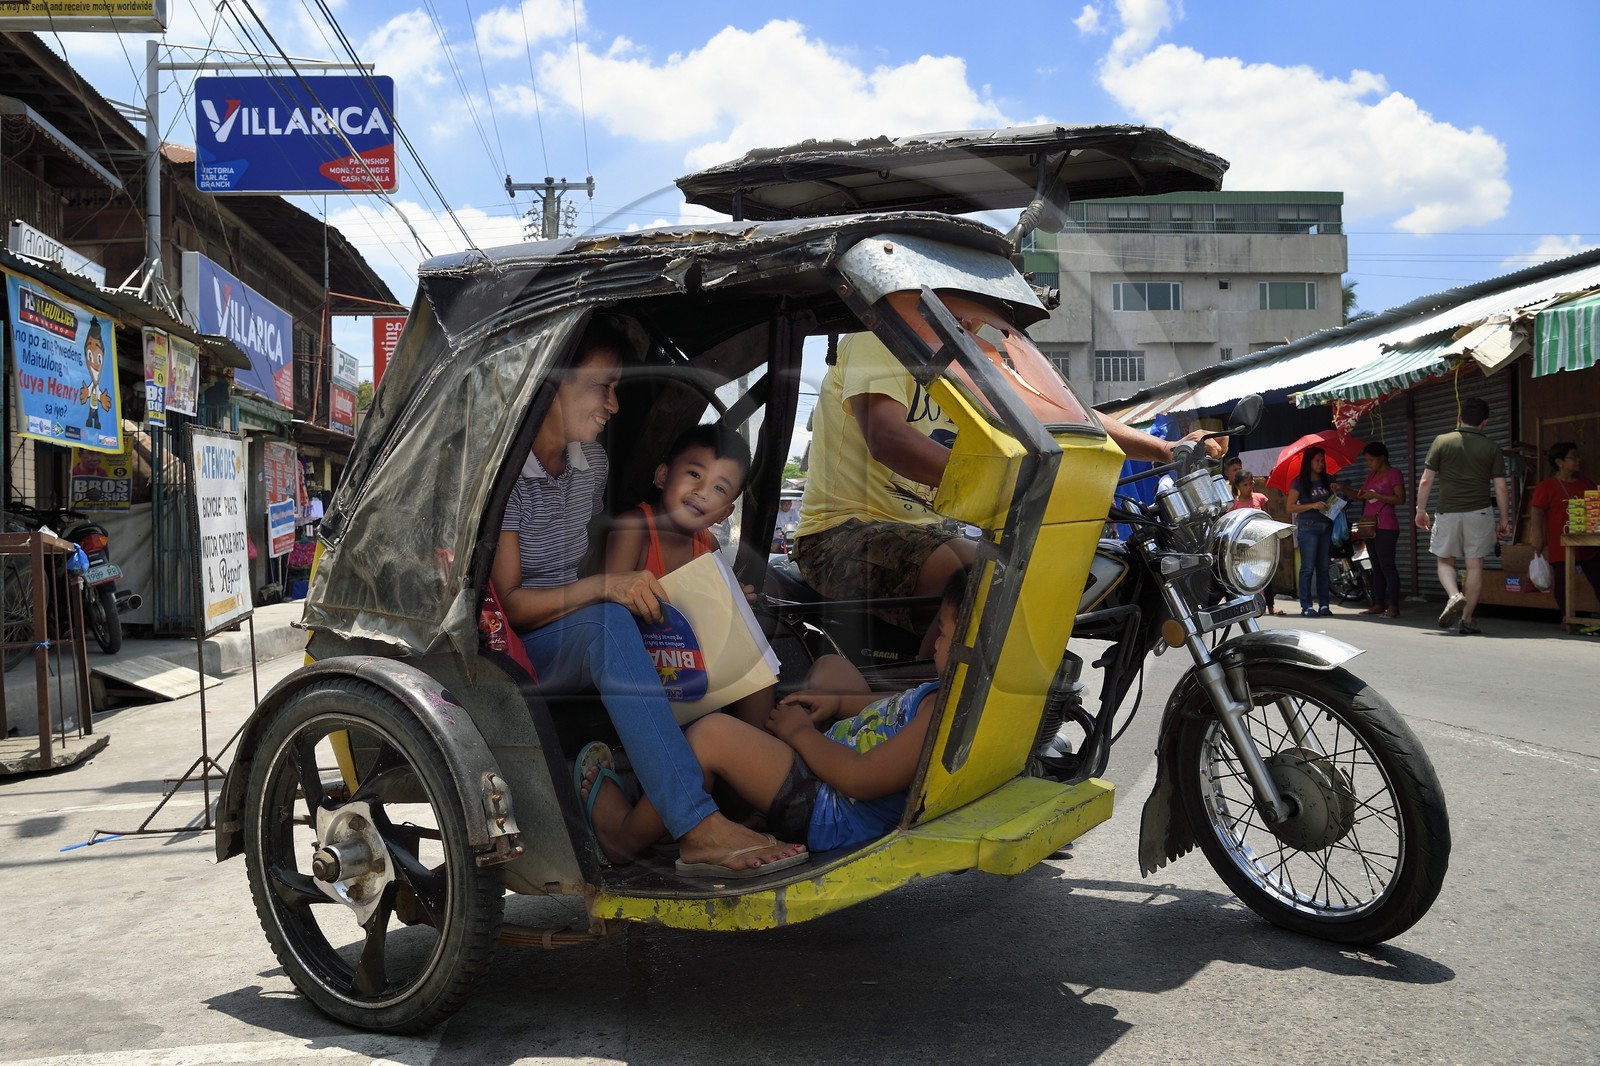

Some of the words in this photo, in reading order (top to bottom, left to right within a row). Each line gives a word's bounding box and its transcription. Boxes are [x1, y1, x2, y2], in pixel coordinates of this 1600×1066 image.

[50, 1, 63, 11] and
[64, 1, 91, 11] receive
[92, 3, 115, 13] money
[117, 1, 153, 11] worldwide
[201, 99, 390, 143] VILLARICA
[213, 276, 284, 366] VILLARICA
[28, 331, 40, 349] po
[22, 349, 63, 377] Maitulong
[47, 376, 80, 406] Henry
[45, 403, 53, 414] sa
[54, 402, 68, 419] iyo?
[74, 480, 129, 493] BROS
[202, 496, 222, 518] BICYCLE
[224, 496, 238, 516] PARTS
[202, 535, 219, 559] MOTOR
[218, 532, 233, 556] CYCLE
[208, 566, 216, 593] &
[218, 557, 243, 595] Repair
[872, 650, 900, 660] RACAL
